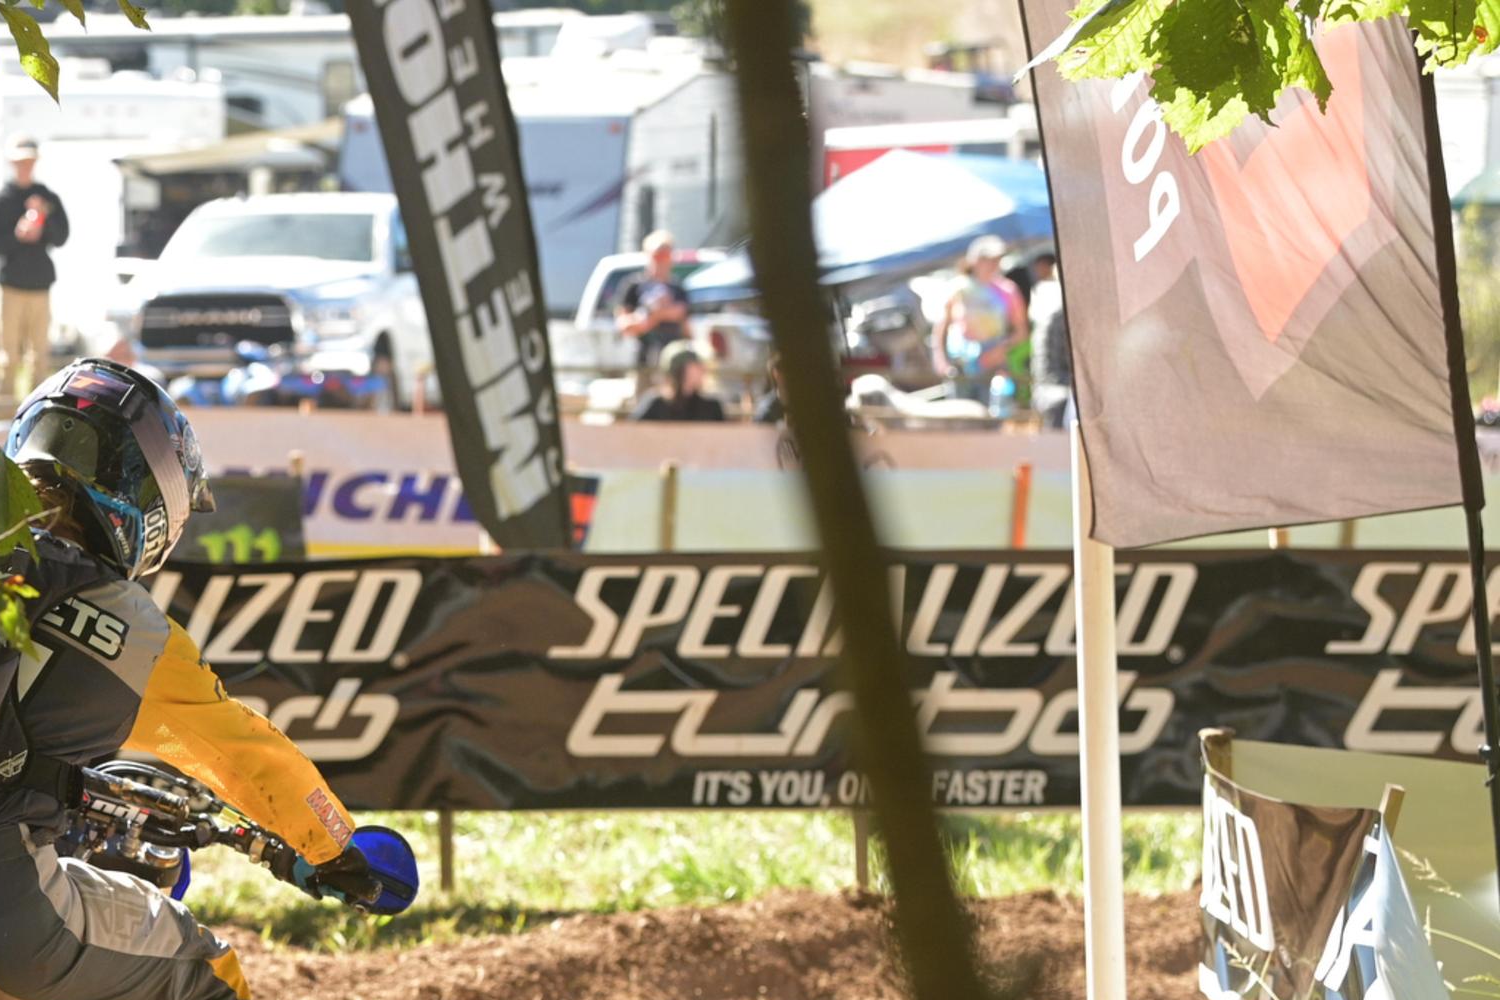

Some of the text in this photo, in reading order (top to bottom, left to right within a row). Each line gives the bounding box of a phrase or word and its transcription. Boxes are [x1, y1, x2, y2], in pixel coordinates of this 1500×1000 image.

[380, 0, 549, 521] METHO
[546, 562, 1197, 658] SPECILIZD
[692, 769, 753, 805] IT'S
[759, 769, 831, 808] YOU,
